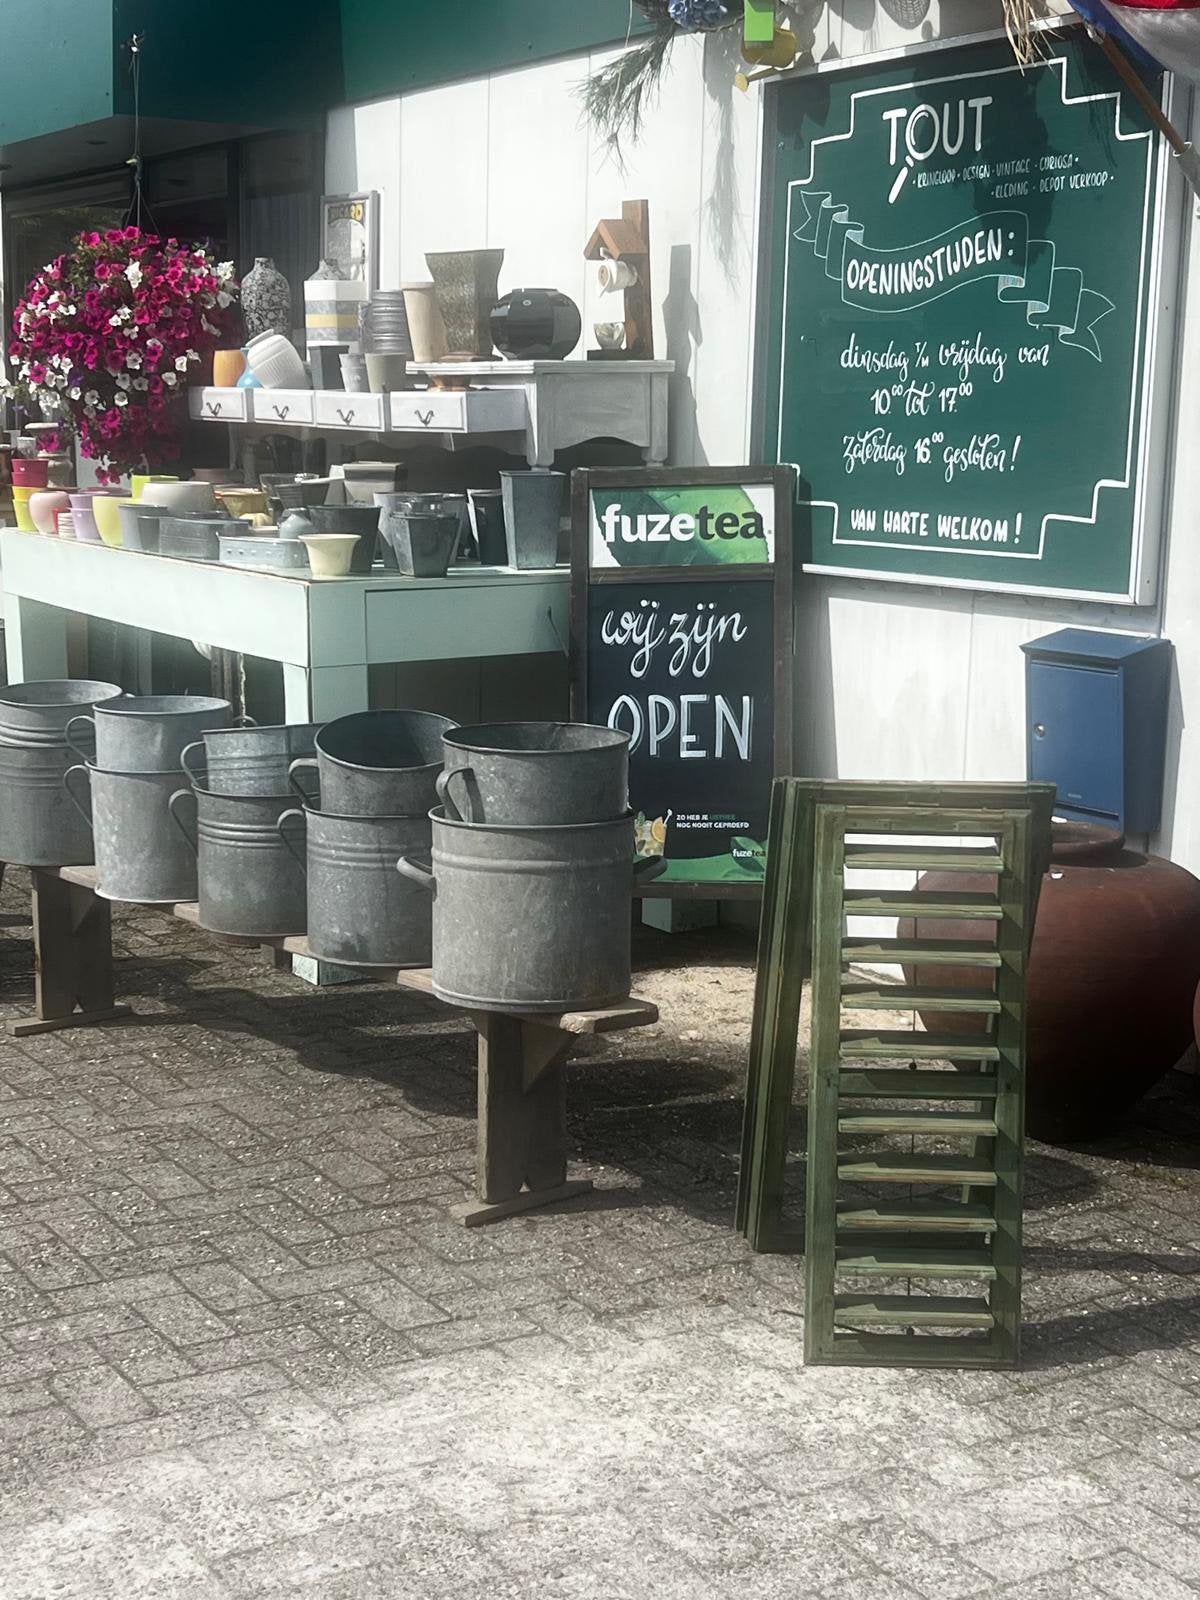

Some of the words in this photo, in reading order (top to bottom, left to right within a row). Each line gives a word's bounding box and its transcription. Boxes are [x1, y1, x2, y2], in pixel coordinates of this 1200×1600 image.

[882, 96, 993, 164] TOUT
[962, 164, 990, 181] DESIGN
[996, 158, 1030, 176] VINTAGE
[1039, 154, 1073, 171] CURIOSA
[994, 181, 1029, 199] KLEDING
[1039, 176, 1065, 193] DEPOT
[1069, 171, 1108, 190] VERKOOP
[840, 332, 909, 381] dinsdag
[1017, 342, 1050, 367] van
[902, 380, 936, 416] tot
[601, 504, 764, 543] fuzetea
[850, 509, 876, 532] VAN
[883, 510, 929, 536] HARTE
[607, 694, 752, 760] OPEN
